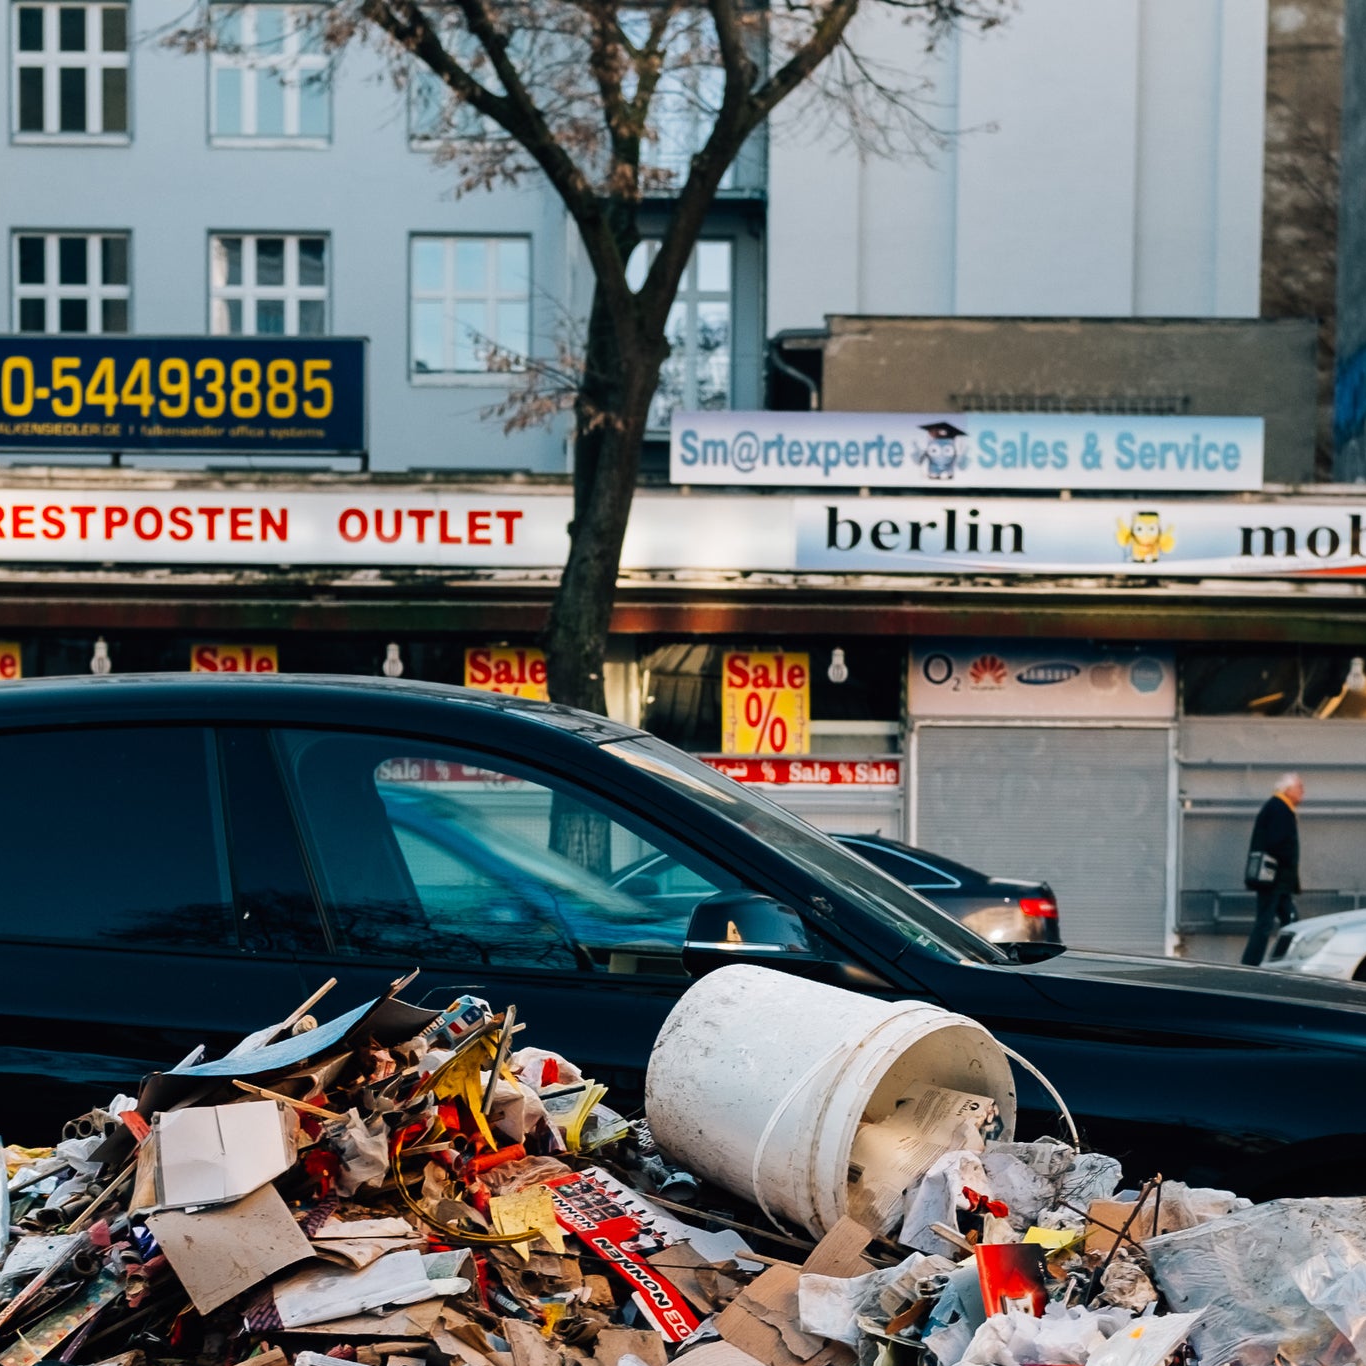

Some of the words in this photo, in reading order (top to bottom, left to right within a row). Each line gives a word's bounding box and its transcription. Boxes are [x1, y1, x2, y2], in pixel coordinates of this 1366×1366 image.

[680, 430, 904, 475] Sm@rtexperte
[978, 430, 1069, 470] Sales
[1080, 432, 1103, 470] &
[1115, 432, 1241, 473] Service
[337, 507, 524, 547] OUTLET
[825, 505, 1026, 555] berlin
[194, 645, 276, 673] Sale
[467, 650, 548, 685] Sale
[726, 653, 806, 691] Sale
[744, 692, 788, 755] %
[789, 762, 832, 783] Sale
[855, 763, 897, 784] Sale
[592, 1236, 673, 1313] NONNEN
[661, 1306, 695, 1341] DE
